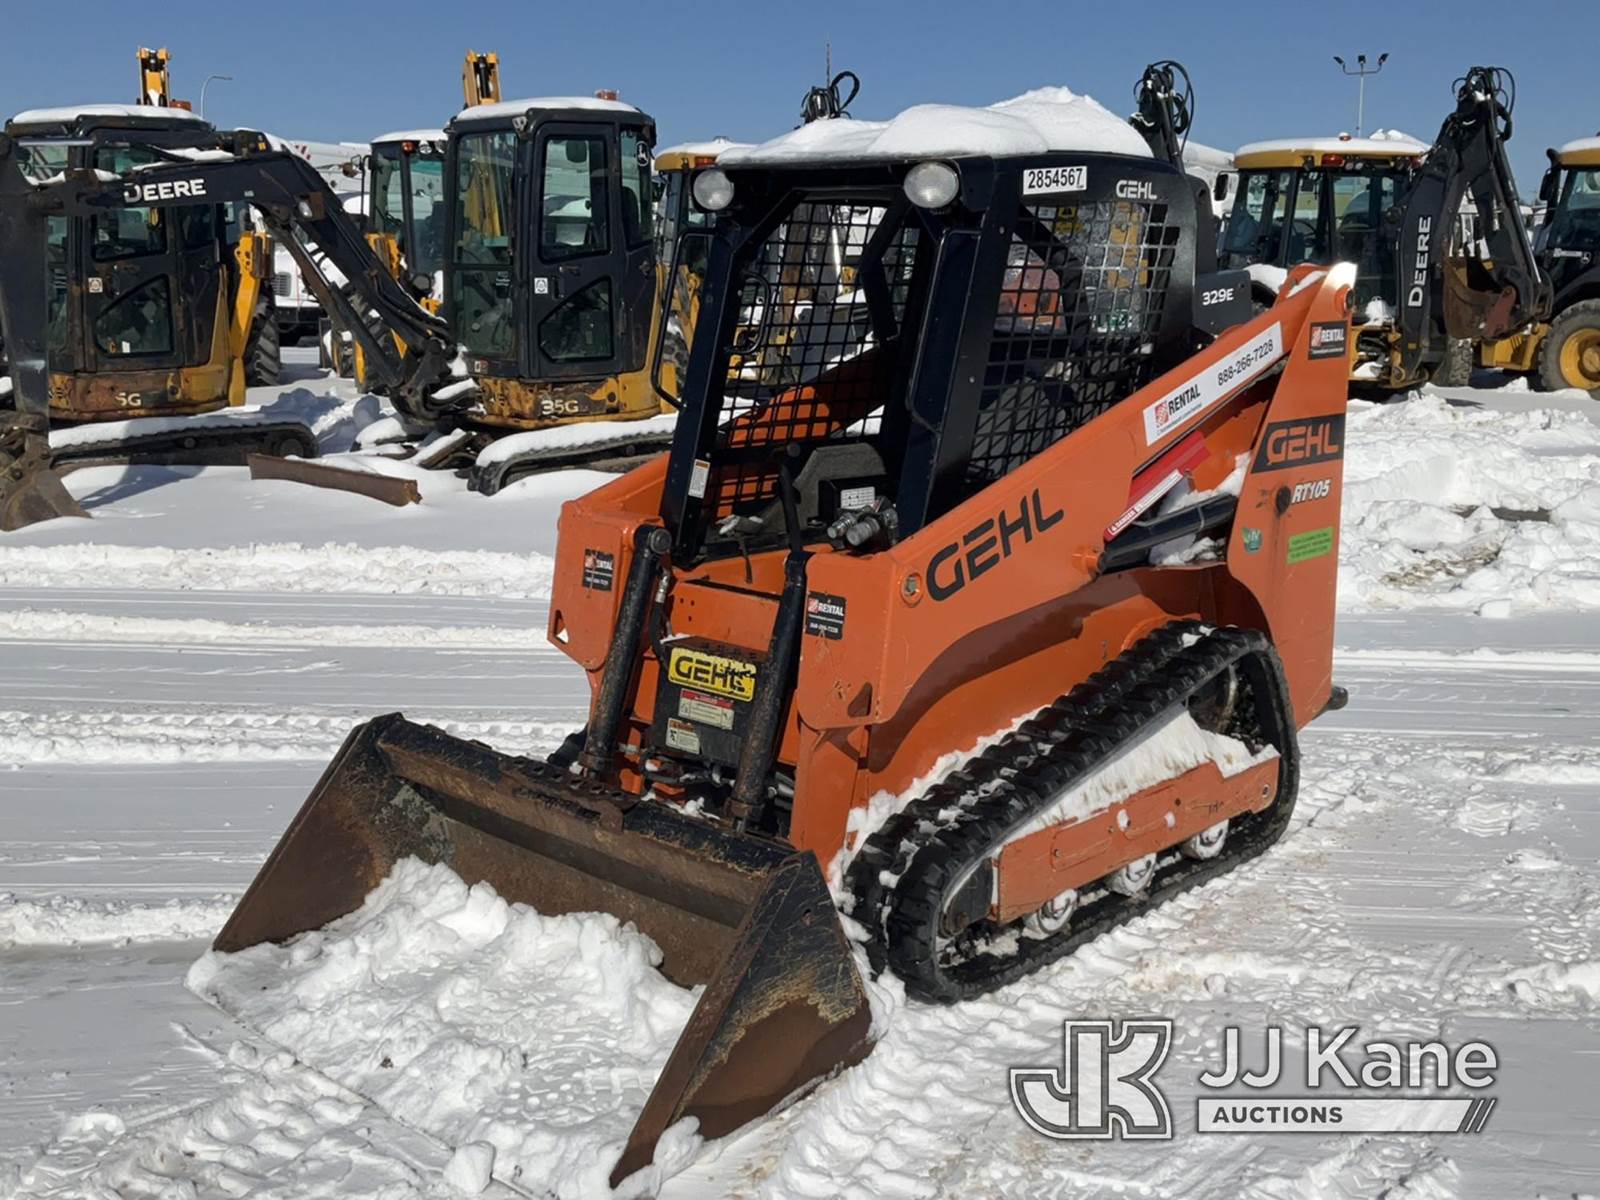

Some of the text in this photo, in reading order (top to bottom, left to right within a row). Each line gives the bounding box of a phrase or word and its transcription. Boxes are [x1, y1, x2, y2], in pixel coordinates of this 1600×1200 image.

[1028, 168, 1083, 189] 2854567
[1116, 179, 1157, 200] GEHL
[123, 179, 206, 203] DEERE
[1408, 216, 1432, 308] DEERE
[1202, 288, 1234, 305] 329E
[1320, 328, 1344, 342] RENTAL
[1168, 384, 1201, 415] RENTAL
[1217, 339, 1274, 386] 888-266-7228
[541, 399, 579, 415] 35G
[1266, 422, 1339, 465] GEHL
[1291, 479, 1331, 503] RT105
[926, 488, 1065, 602] GEHL
[818, 602, 844, 616] RENTAL
